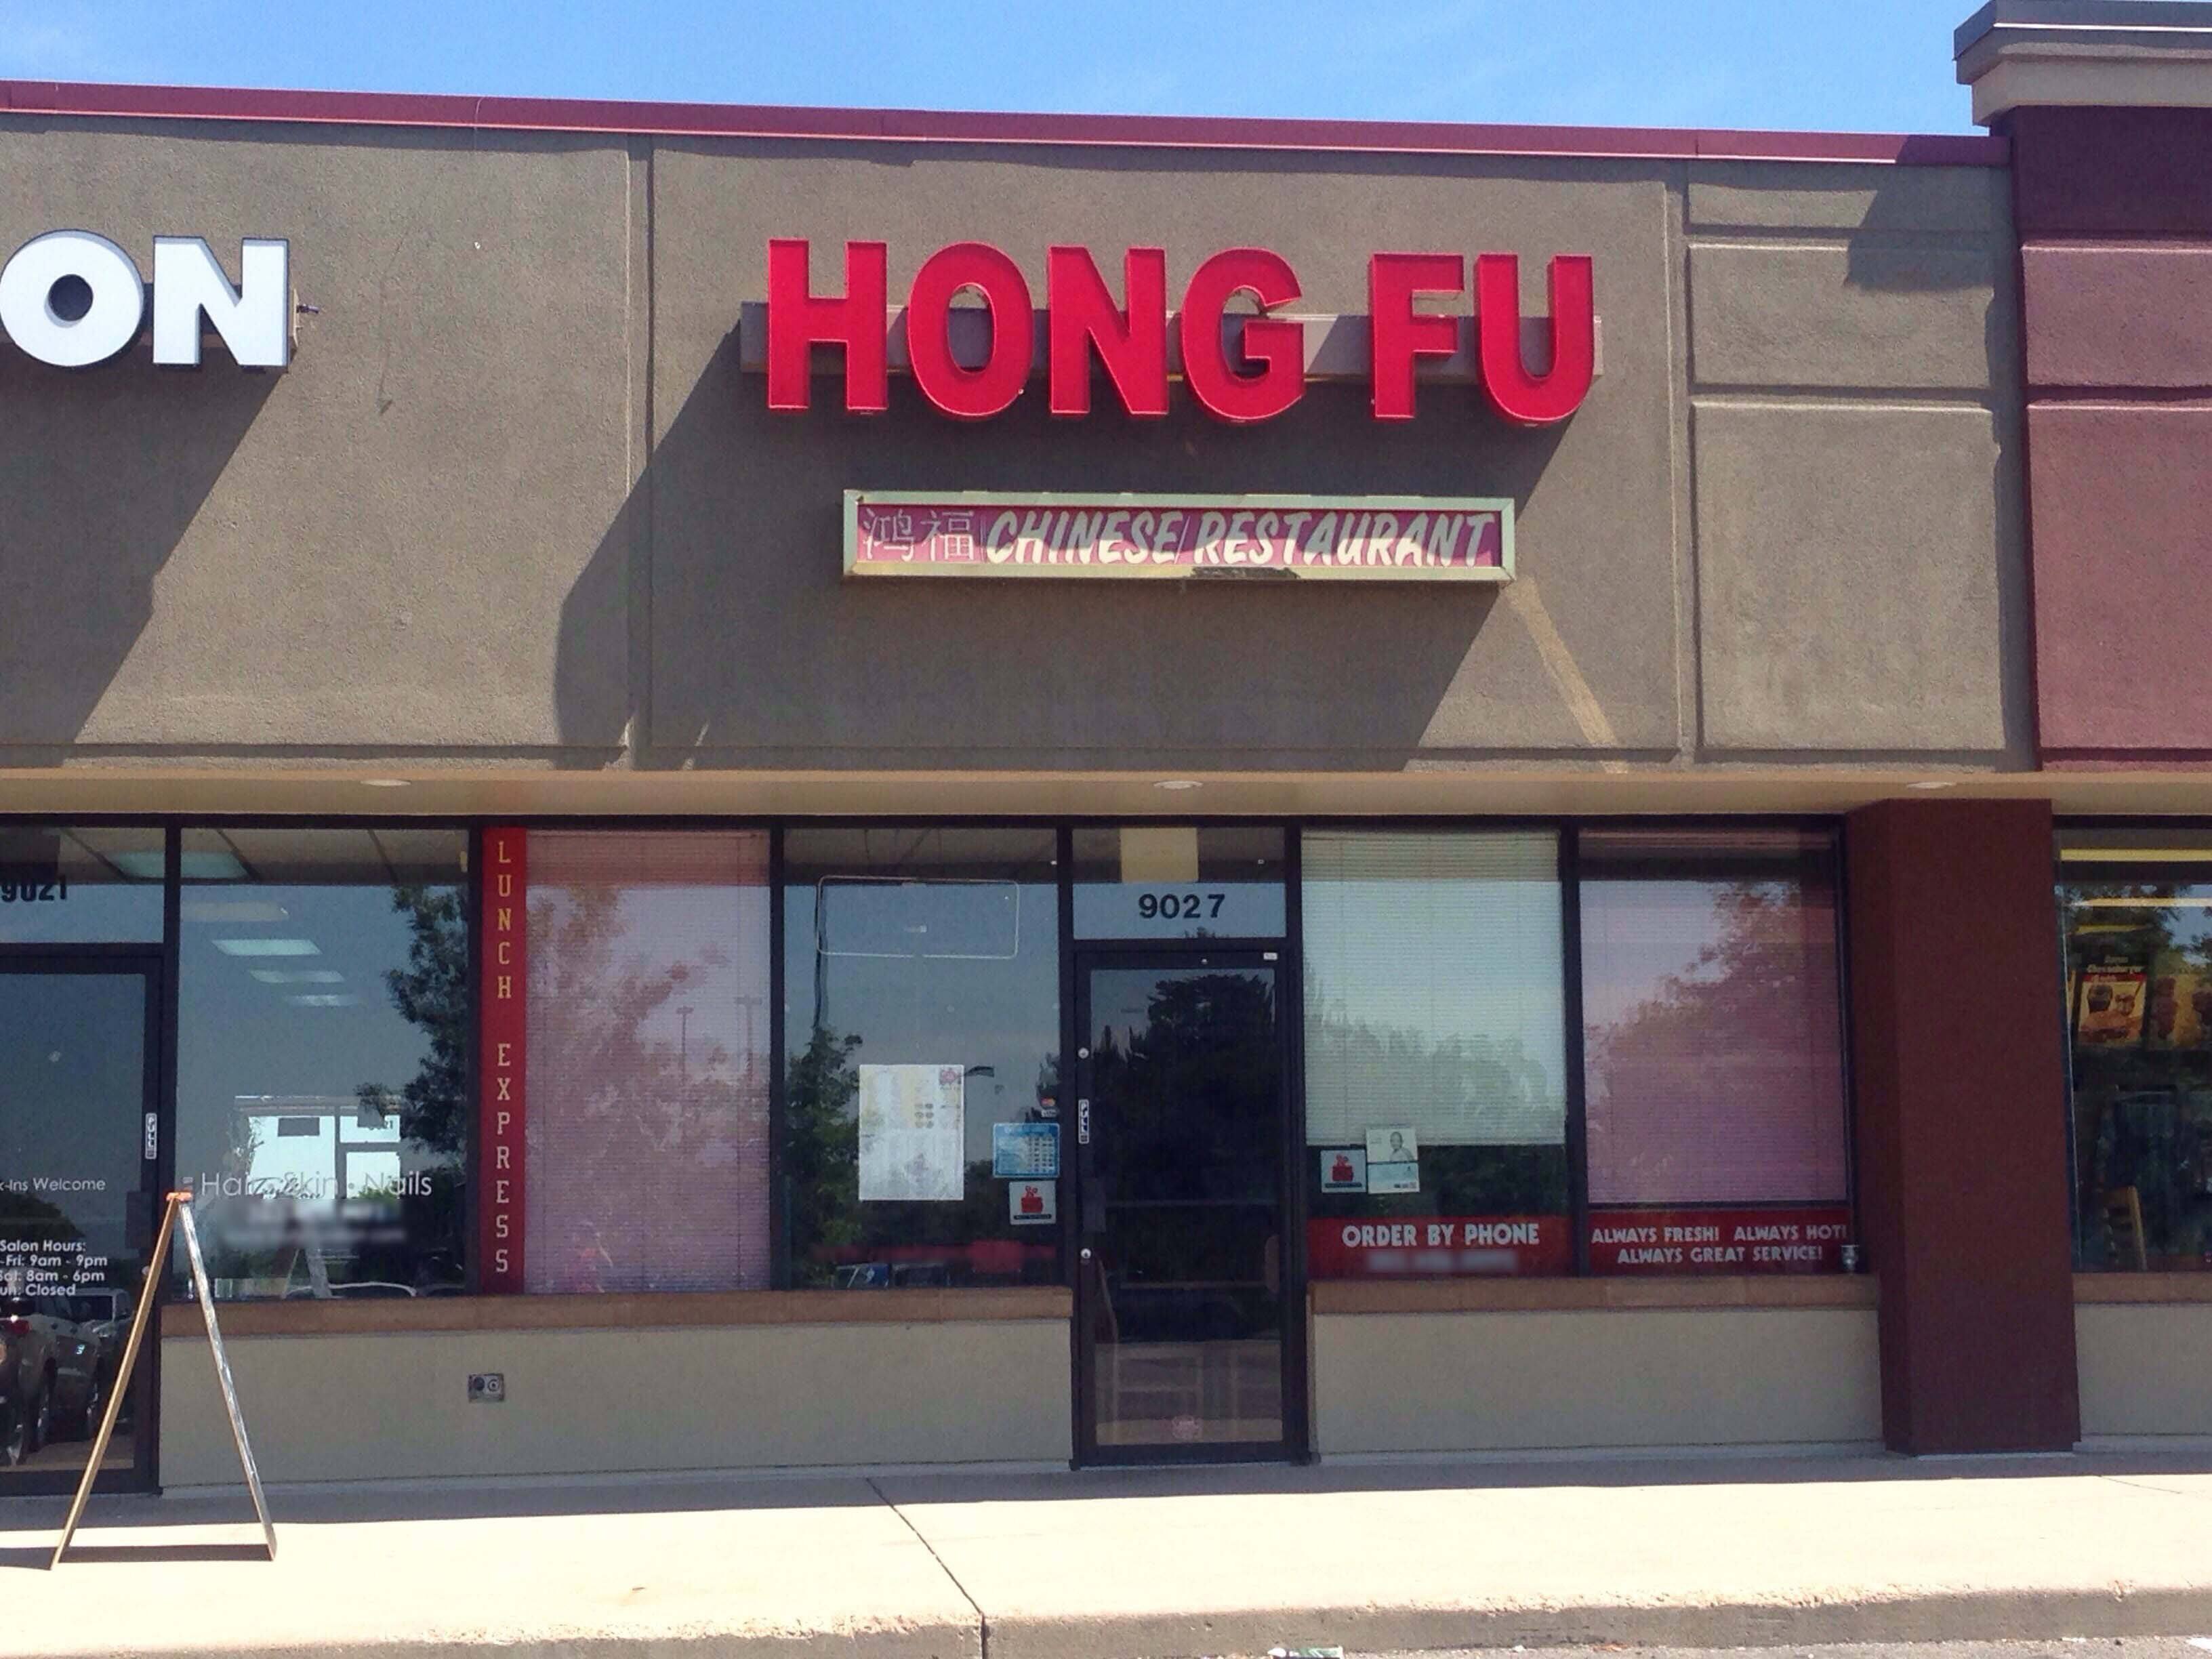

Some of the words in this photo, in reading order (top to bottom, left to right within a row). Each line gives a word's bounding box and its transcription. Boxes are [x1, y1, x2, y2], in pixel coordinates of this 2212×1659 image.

[0, 229, 289, 367] ON
[766, 239, 1306, 422] HONG
[1367, 253, 1595, 426] FU
[862, 508, 975, 562] 鸿福
[986, 510, 1183, 565] CHINESE
[1193, 511, 1496, 569] RESTAURANT
[1138, 893, 1226, 919] 9027
[497, 840, 512, 999] LUNCH
[495, 1043, 512, 1273] EXPRESS
[33, 1177, 106, 1191] Welcome
[365, 1172, 433, 1196] Nails
[0, 1240, 39, 1252] Salon
[43, 1240, 87, 1252] Hours:
[1342, 1225, 1417, 1248] ORDER
[1427, 1224, 1454, 1246] BY
[1465, 1223, 1540, 1246] PHONE
[1591, 1227, 1658, 1244] ALWAYS
[1664, 1226, 1719, 1242] FRESH!
[1734, 1225, 1800, 1242] ALWAYS
[1807, 1225, 1847, 1239] HOT!
[30, 1254, 62, 1267] 9am
[76, 1254, 108, 1268] 9pm
[1617, 1248, 1683, 1264] ALWAYS
[1690, 1247, 1745, 1263] GREAT
[1753, 1246, 1823, 1262] SERVICE!
[26, 1270, 58, 1282] 8am
[73, 1270, 105, 1283] 6pm
[25, 1284, 76, 1296] Closed
